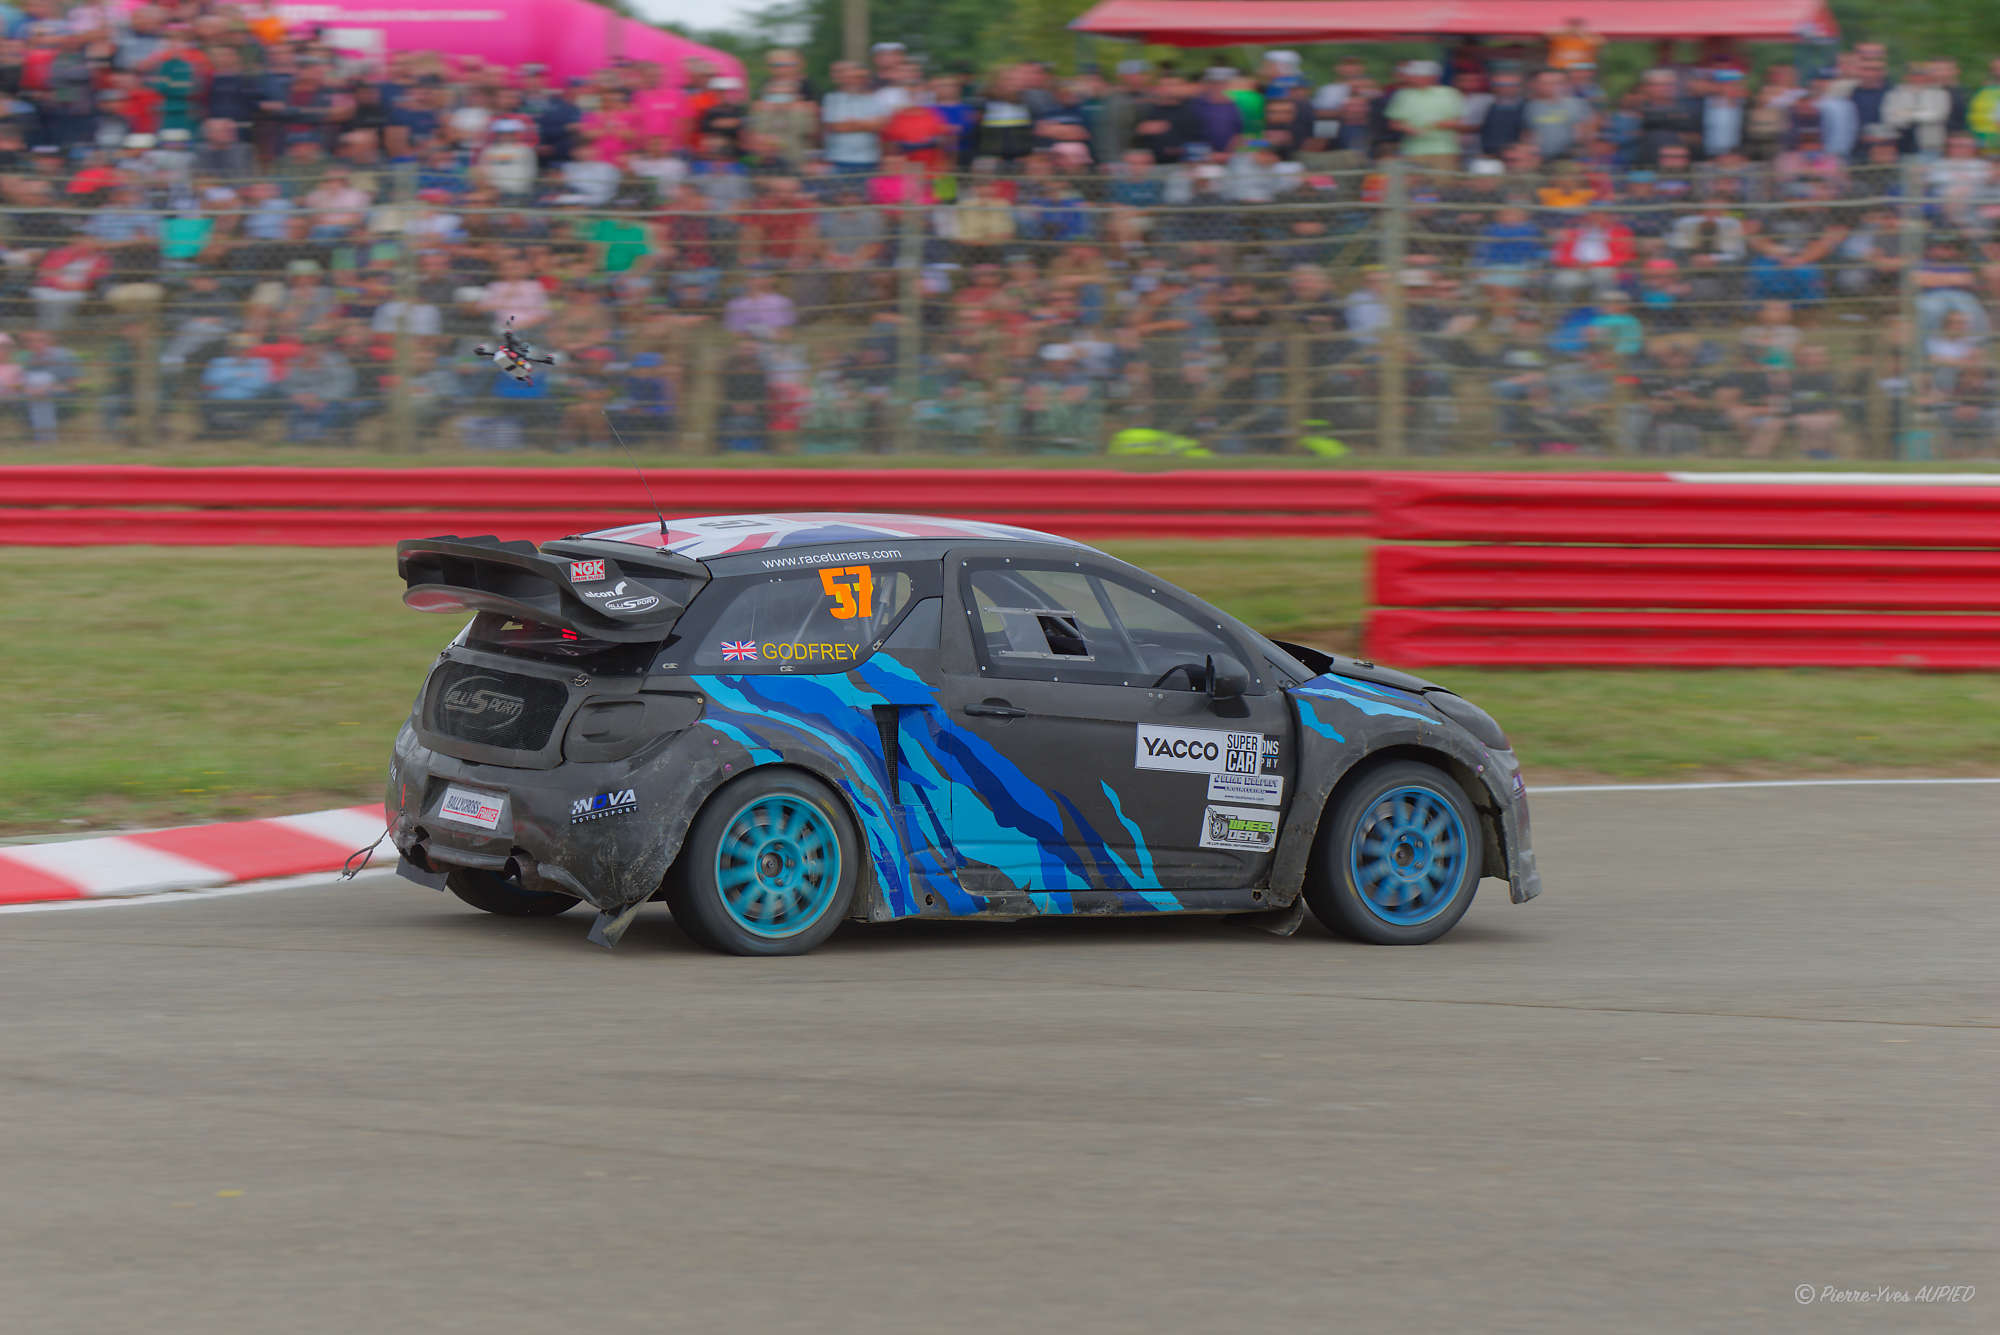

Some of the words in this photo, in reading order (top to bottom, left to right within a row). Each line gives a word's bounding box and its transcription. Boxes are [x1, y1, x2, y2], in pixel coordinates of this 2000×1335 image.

[571, 559, 604, 577] NGK
[761, 548, 903, 569] www.racetuners.com
[584, 590, 616, 599] alcon
[818, 565, 873, 619] 57
[762, 642, 860, 661] GODFREY
[1143, 737, 1219, 761] YACCO
[1227, 734, 1258, 750] SUPER
[1227, 751, 1255, 773] CAR
[1260, 758, 1280, 769] PHY
[571, 788, 637, 815] NOVA
[1229, 819, 1275, 832] WHEEL
